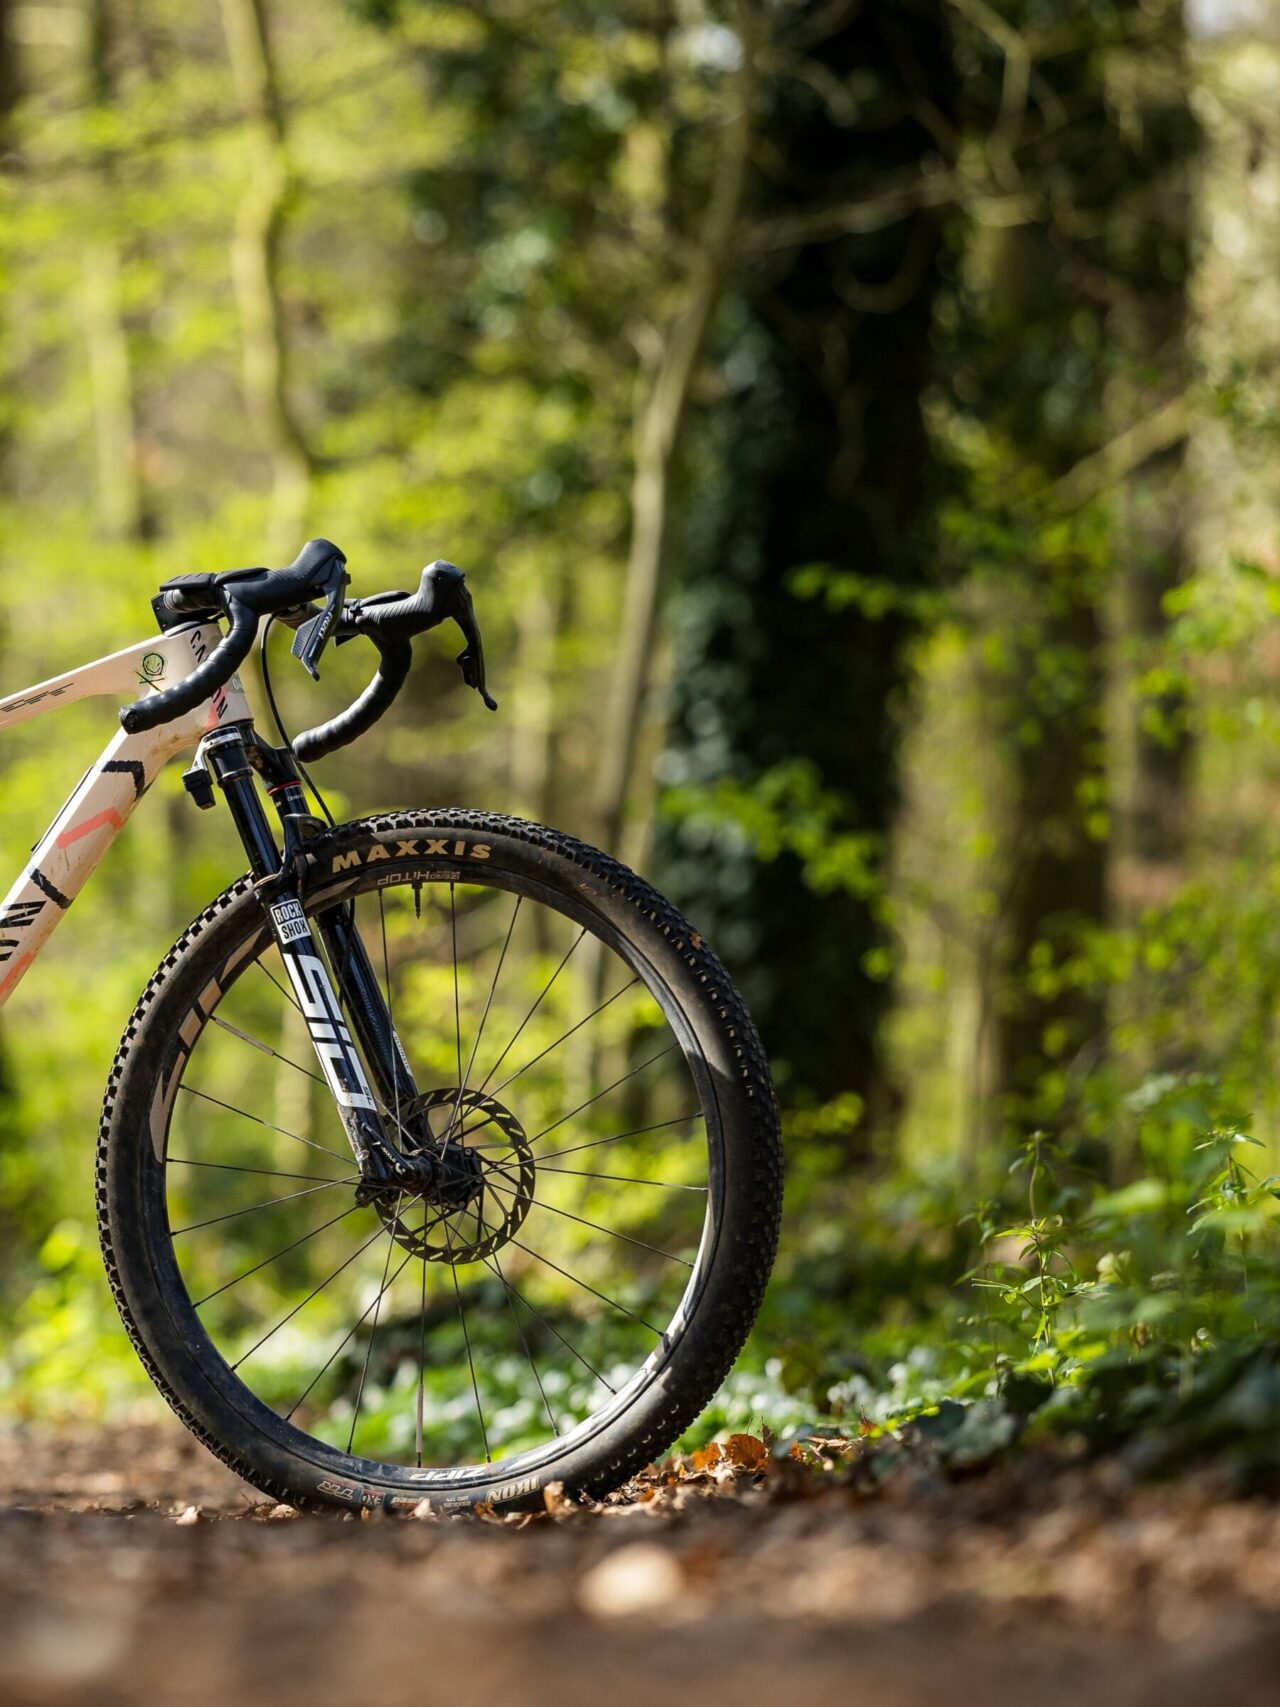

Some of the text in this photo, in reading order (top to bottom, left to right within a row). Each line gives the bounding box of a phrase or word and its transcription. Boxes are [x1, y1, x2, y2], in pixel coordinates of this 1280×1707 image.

[332, 838, 492, 873] MAXXIS
[274, 904, 303, 924] ROCK
[281, 918, 308, 939] SHOX
[282, 953, 378, 1112] SID
[408, 1465, 487, 1481] ZIPP
[316, 1480, 354, 1500] TR
[485, 1475, 540, 1504] IKON
